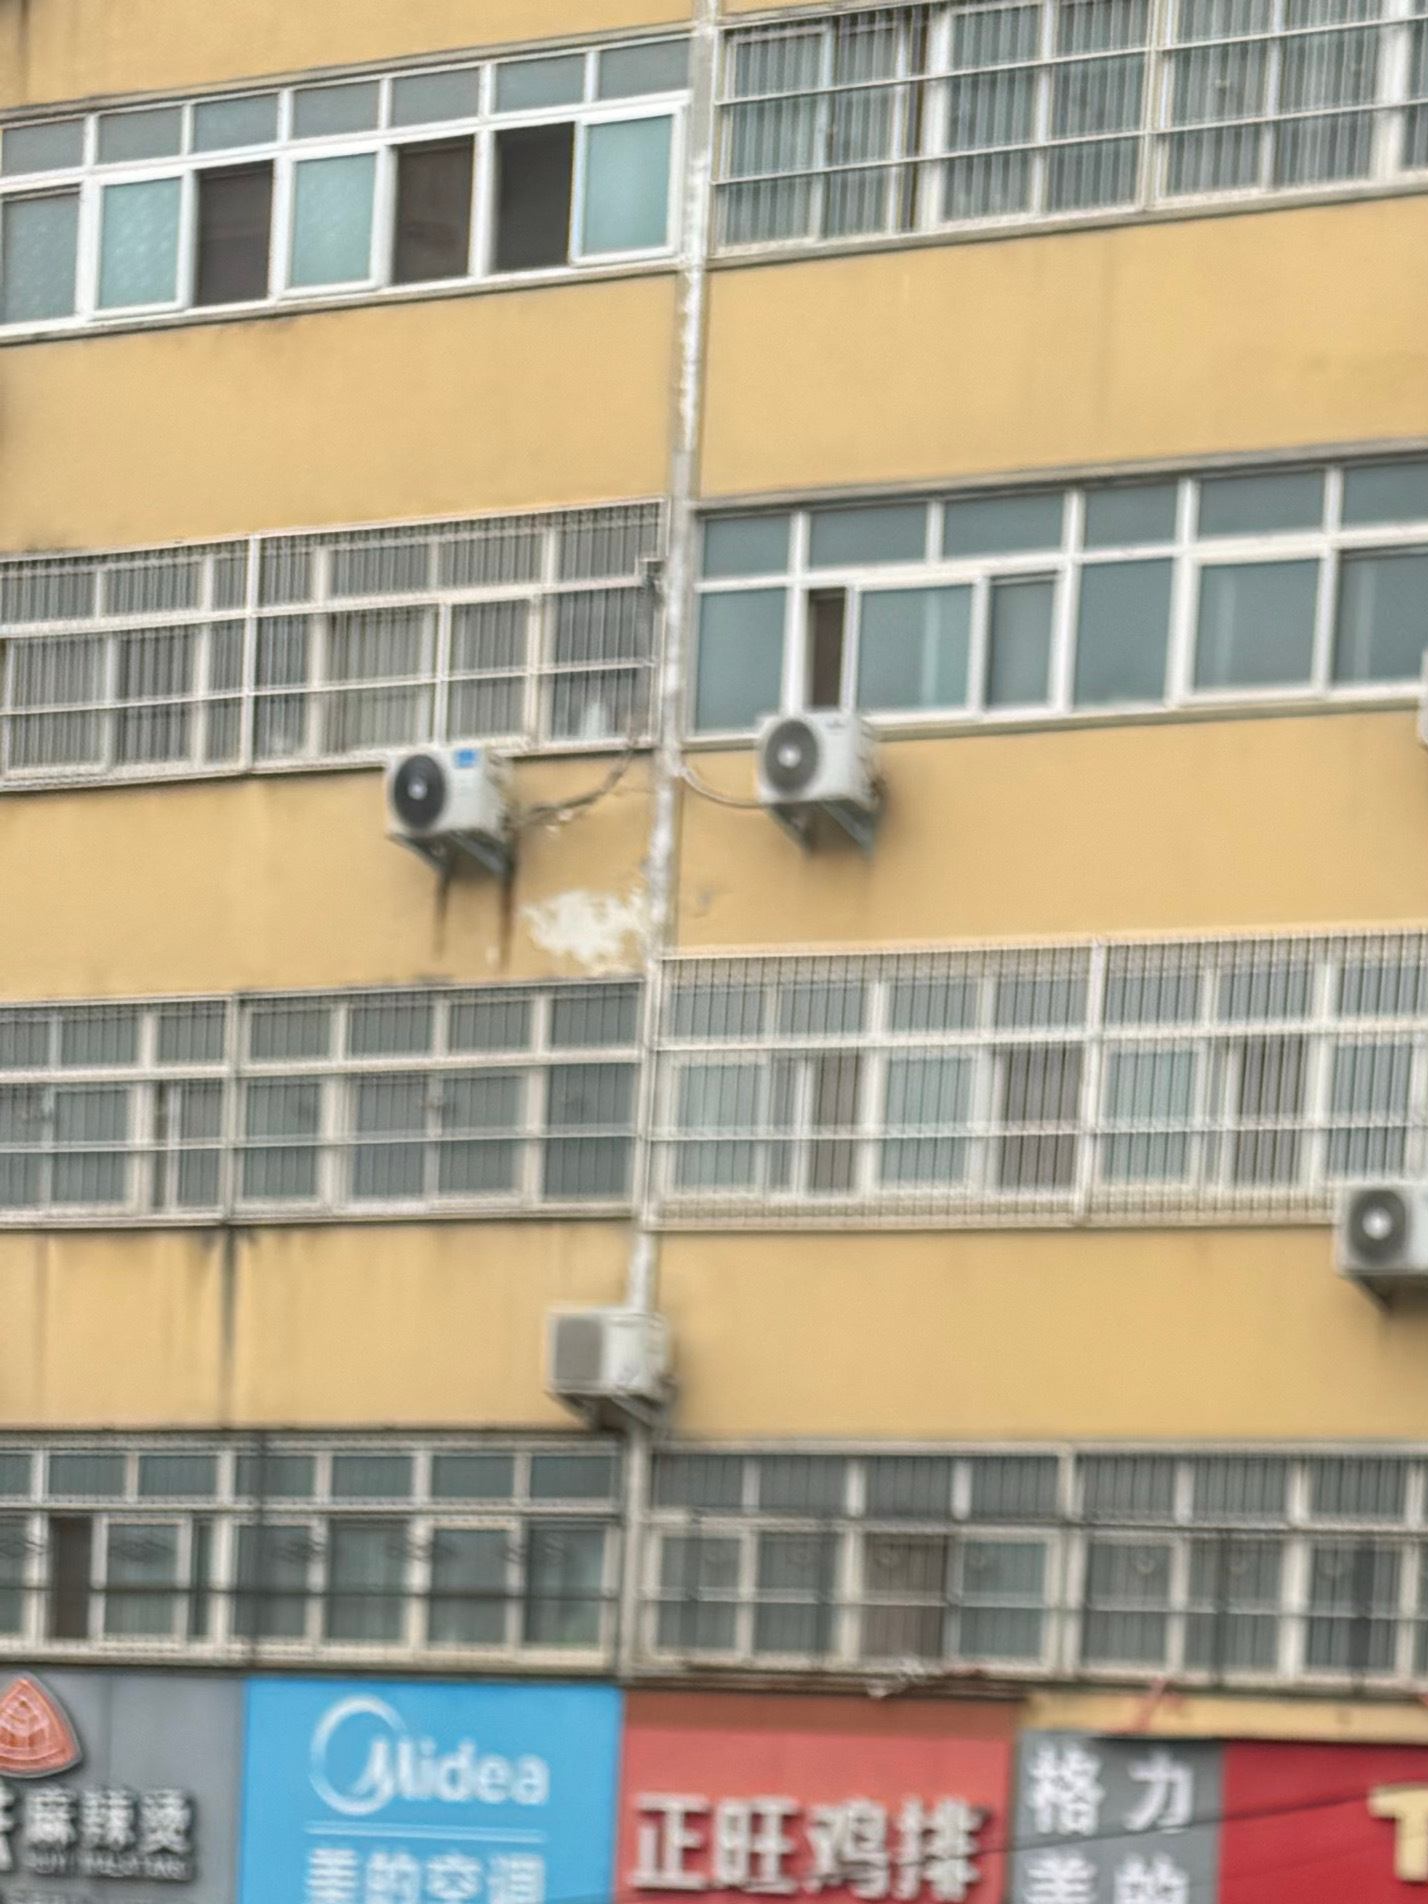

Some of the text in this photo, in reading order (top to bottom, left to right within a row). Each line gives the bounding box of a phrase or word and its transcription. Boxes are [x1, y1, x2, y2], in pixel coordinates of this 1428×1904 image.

[318, 1703, 550, 1814] Midea
[1026, 1742, 1193, 1836] 格力
[630, 1792, 984, 1904] 正旺鸡排
